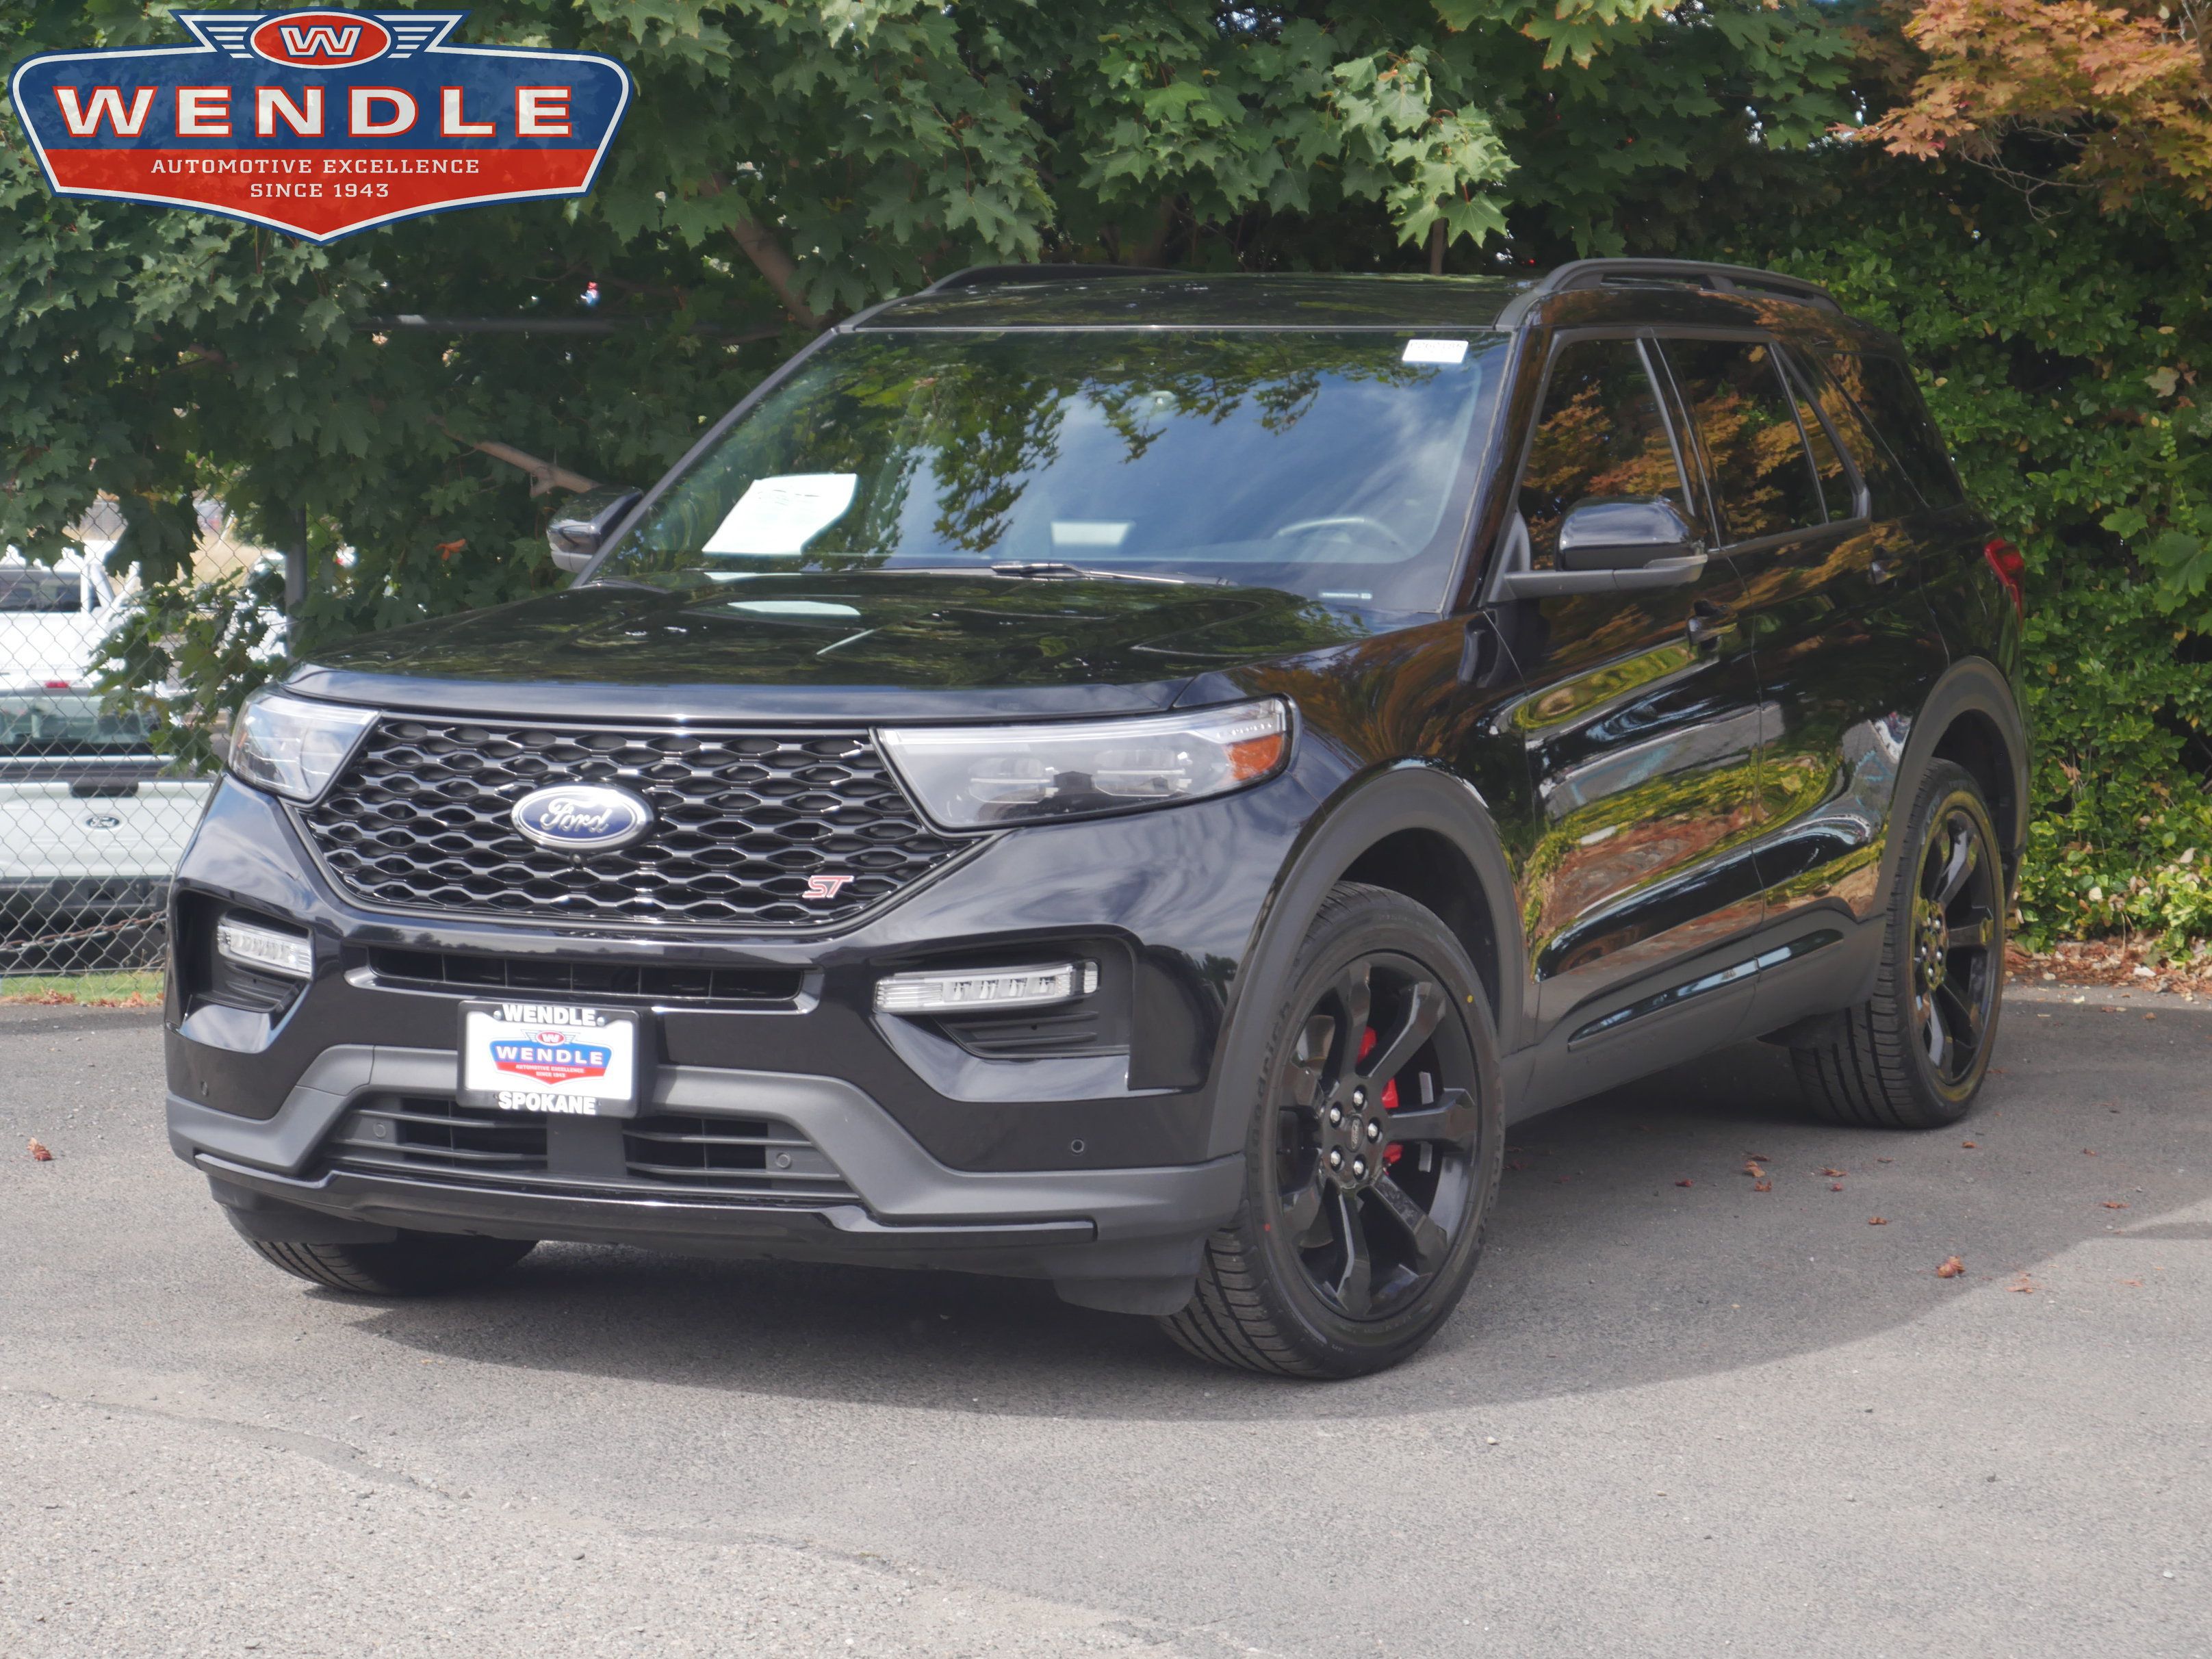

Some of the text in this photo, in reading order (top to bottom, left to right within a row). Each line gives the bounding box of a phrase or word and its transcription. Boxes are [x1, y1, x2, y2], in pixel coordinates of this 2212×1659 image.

[539, 797, 615, 834] Ford
[802, 875, 854, 899] ST
[502, 1004, 597, 1027] WENDLE
[496, 1045, 603, 1065] WENDLE
[498, 1090, 597, 1115] SPOKANE
